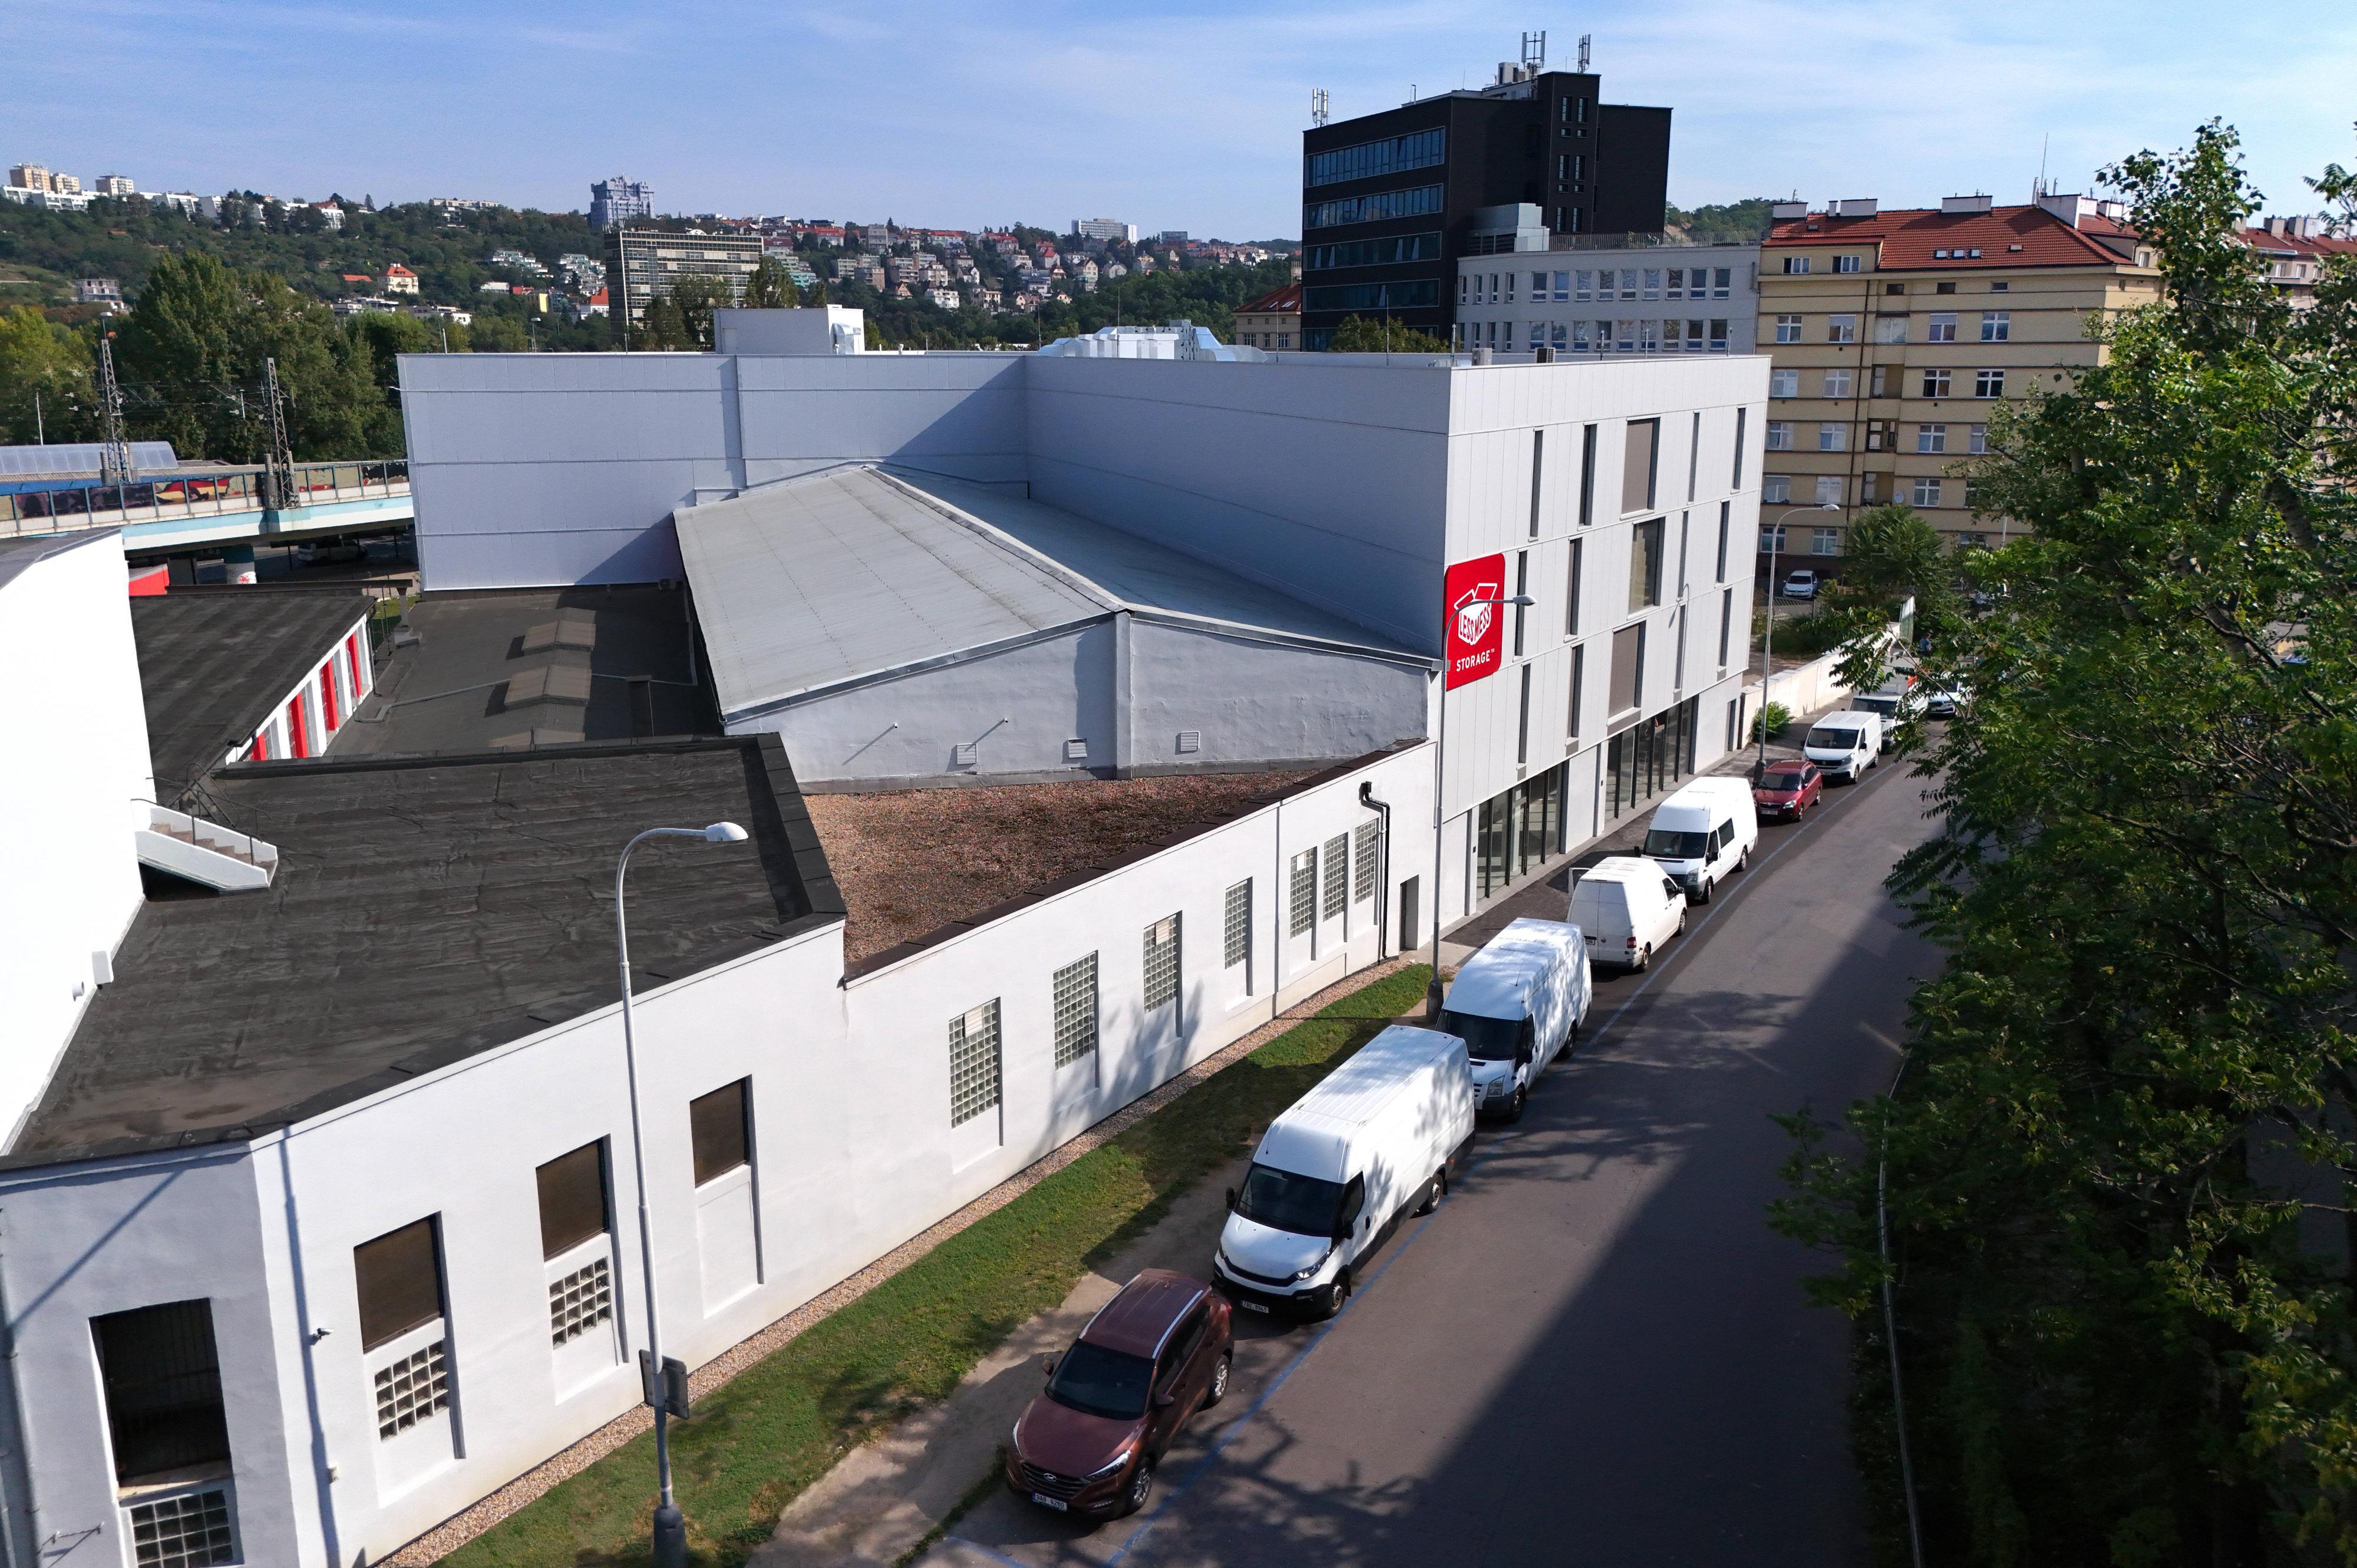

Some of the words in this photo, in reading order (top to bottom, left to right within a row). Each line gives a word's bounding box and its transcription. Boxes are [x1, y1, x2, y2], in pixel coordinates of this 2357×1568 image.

[1460, 612, 1473, 642] LESS
[1474, 602, 1490, 642] MESS
[1456, 649, 1490, 672] STORAGE
